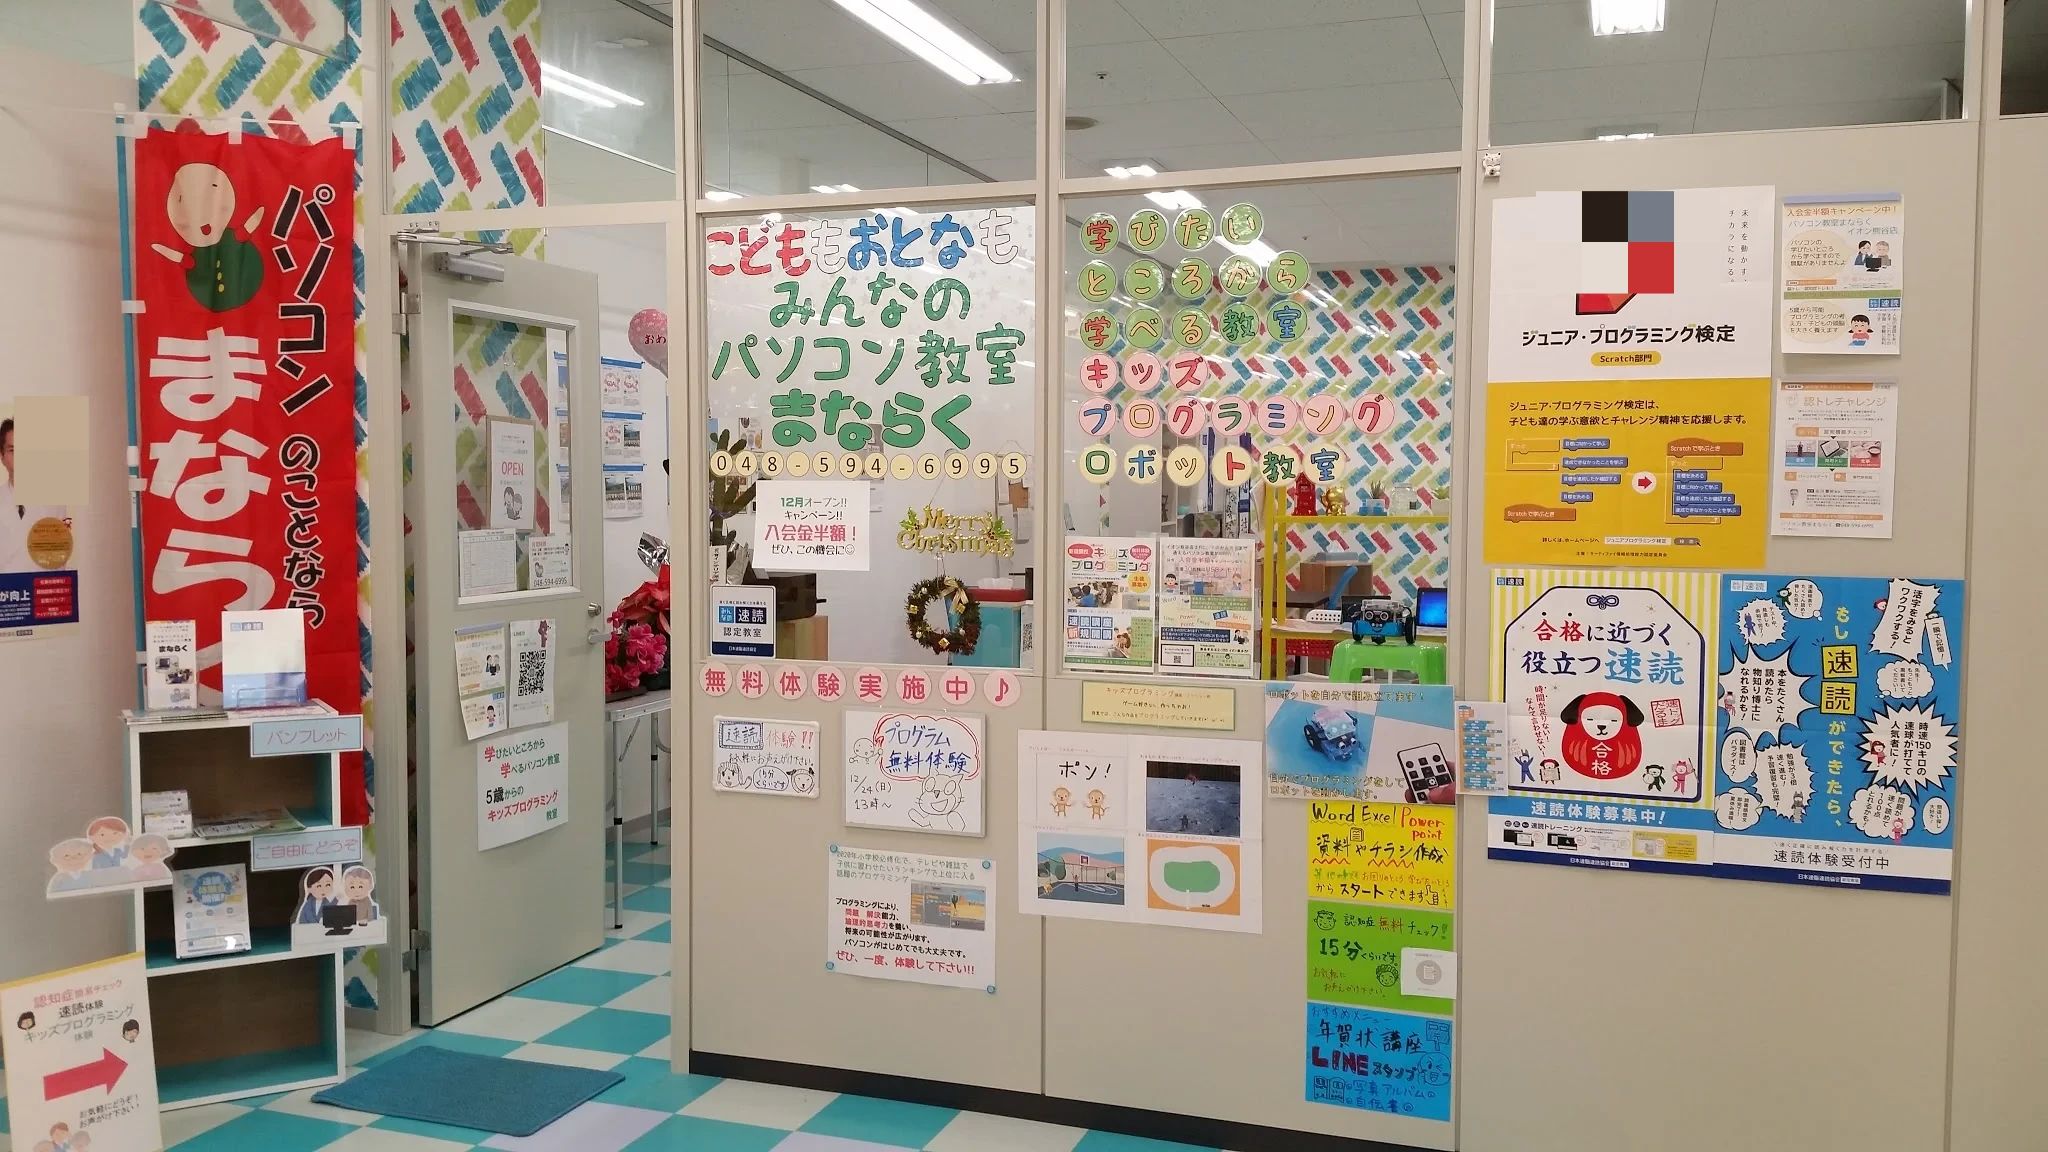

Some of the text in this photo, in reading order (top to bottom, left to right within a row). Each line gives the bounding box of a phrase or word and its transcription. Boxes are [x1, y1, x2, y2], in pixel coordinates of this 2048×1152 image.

[1787, 206, 1897, 217] 入会金半額キャンペーン中！
[1788, 217, 1872, 228] パソコン教室まならく
[707, 209, 1019, 277] こどももおとなも
[1086, 213, 1256, 252] 学びたい
[1727, 209, 1735, 283] チカラになる。
[1741, 209, 1750, 283] 未来を動かす、
[1086, 258, 1298, 296] ところから
[271, 184, 336, 416] パソコン
[769, 271, 971, 328] みんなの
[1083, 305, 1302, 347] 学べる教室
[1522, 323, 1736, 347] ジュニア・プログラミング検定
[711, 321, 1026, 388] パソコン教室
[1599, 353, 1653, 364] Scratch部門
[1086, 356, 1204, 389] キッズ
[770, 388, 972, 451] まならく
[1083, 394, 1384, 435] プログラミング
[1509, 400, 1660, 412] ジュニア・プログラミング検定は、
[1508, 414, 1748, 427] 子ども達の学ぶ意欲とチャレンジ精神を応援します。
[501, 460, 524, 476] OPEN
[714, 455, 1021, 476] 048-594-6995
[1085, 447, 1340, 482] ロボット教室
[783, 509, 843, 521] キャンペーン!!
[920, 505, 994, 535] Merry
[764, 524, 857, 543] 入会金半額！
[897, 530, 1015, 559] Christmas
[738, 608, 764, 623] 速読
[1890, 587, 1911, 649] ワクワクする！
[1902, 589, 1924, 645] 活字をみると
[723, 626, 762, 638] 認定教室
[1532, 618, 1673, 646] 合格に近づく
[159, 645, 188, 653] まならく
[1520, 647, 1685, 685] 役立つ速読
[1269, 689, 1425, 702] ロボットを自分で組み立てます！
[1738, 668, 1751, 721] なれるかも！
[1750, 668, 1763, 722] 物知り博士に
[1763, 668, 1776, 706] 読めたら
[1774, 668, 1787, 723] 本をたくさん
[267, 727, 347, 745] パンフレット
[725, 726, 759, 744] 速読
[885, 721, 951, 748] プログラム
[1889, 720, 1900, 767] 人気者に！
[484, 738, 546, 763] 学びたいところから
[885, 748, 972, 775] 無料体験
[1591, 741, 1613, 776] 合格
[1729, 739, 1738, 777] パラダイス！
[1903, 721, 1915, 776] 速球が打てて
[1914, 721, 1932, 776] 時速150キロの
[500, 752, 560, 779] 学べるパソコン教室
[756, 780, 786, 790] くらいです
[1269, 772, 1405, 788] 自分でプログラミングをして
[485, 785, 524, 805] 5歳からの
[487, 789, 559, 823] キッズプログラミング
[546, 808, 558, 822] 教室
[1312, 802, 1445, 828] Word Excel Power
[1530, 800, 1667, 825] 速読体験募集中！
[1412, 827, 1443, 841] point
[1530, 822, 1583, 833] 速読トレーニング
[255, 837, 359, 861] ご自由にどうぞ
[1773, 849, 1890, 870] 速読体験受付中
[835, 897, 900, 912] プログラミングにより、
[844, 927, 931, 944] 将来の可能性が広がります。
[844, 938, 967, 959] パソコンがはじめてでも大丈夫です。
[58, 999, 104, 1019] 速読体験
[1311, 1006, 1393, 1023] おすすめメニュー
[24, 1003, 135, 1043] キッズプログラミング
[74, 1030, 94, 1043] 体験
[1315, 1018, 1425, 1055] 年賀状講座
